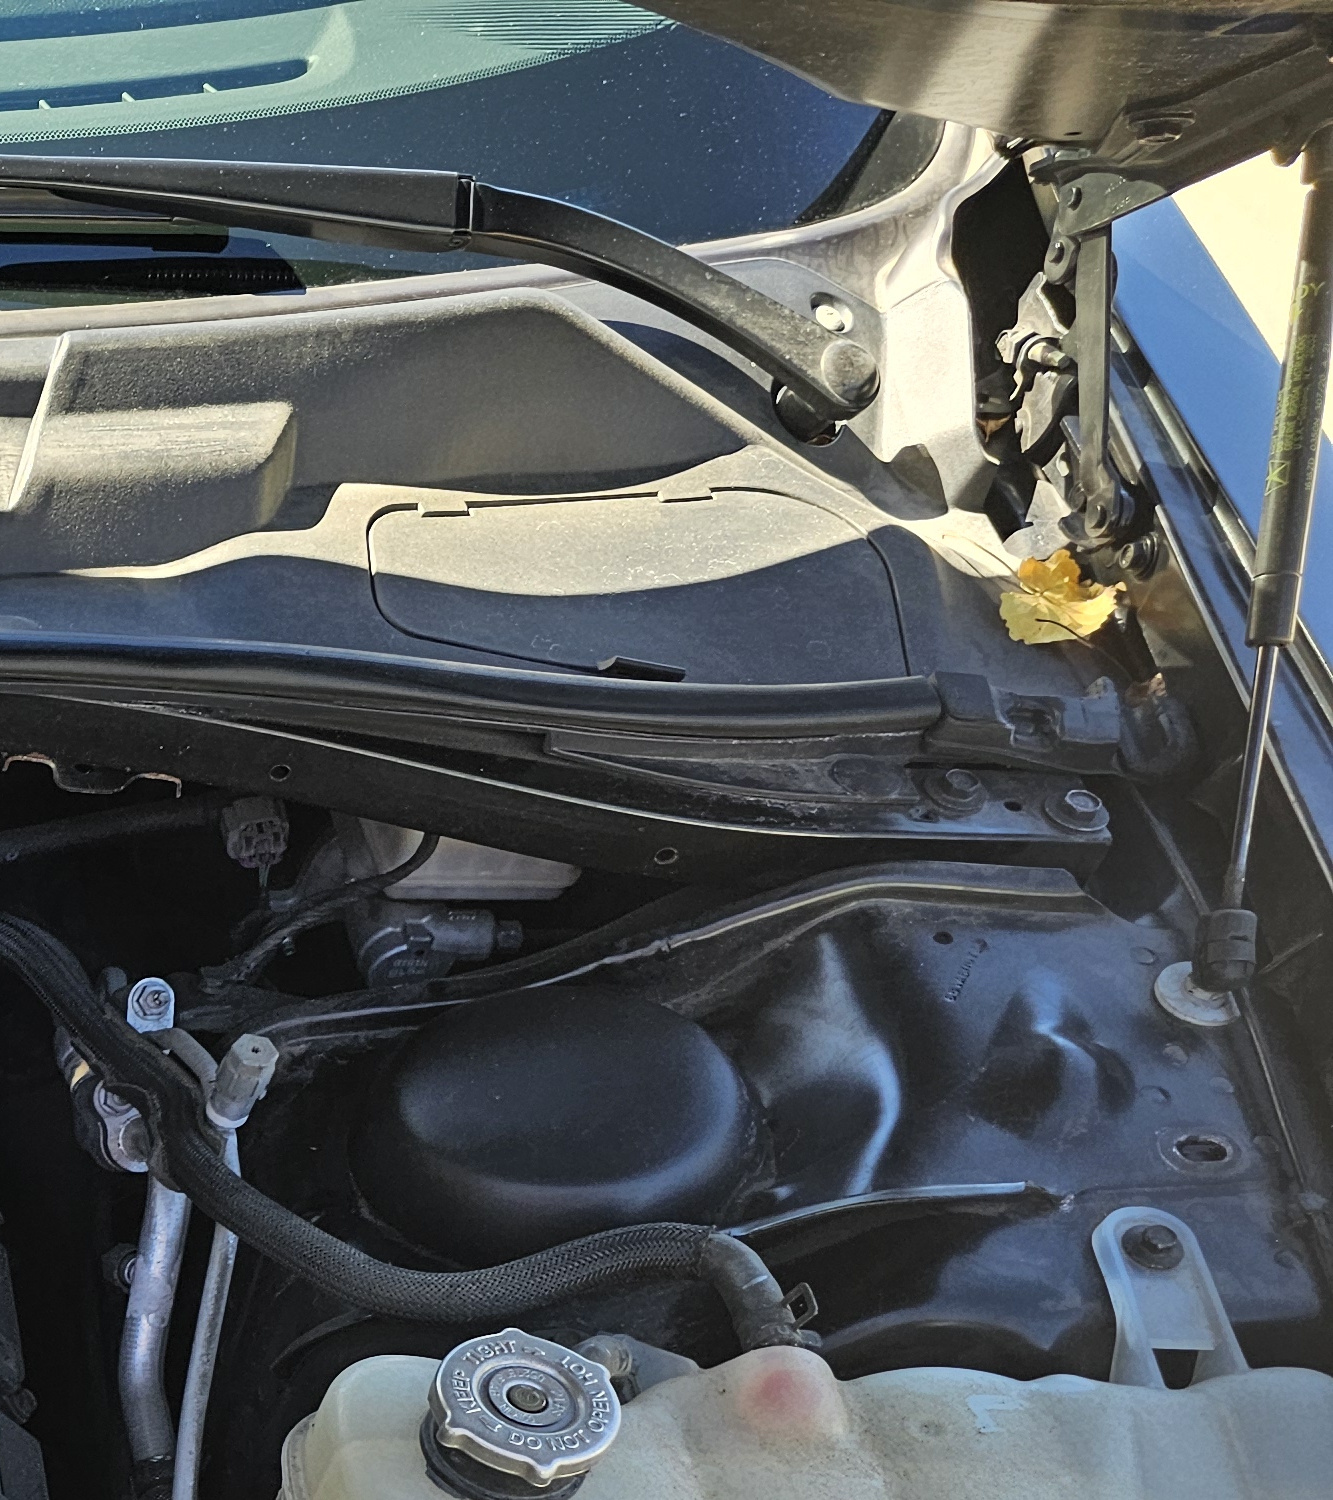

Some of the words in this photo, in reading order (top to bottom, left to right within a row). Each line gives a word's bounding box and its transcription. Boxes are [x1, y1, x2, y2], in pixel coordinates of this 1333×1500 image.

[463, 1340, 517, 1365] TIGHT
[560, 1355, 599, 1386] HOT
[452, 1368, 482, 1414] KEEP
[587, 1389, 611, 1433] OPEN
[508, 1431, 542, 1450] DO
[546, 1428, 591, 1451] NOT
